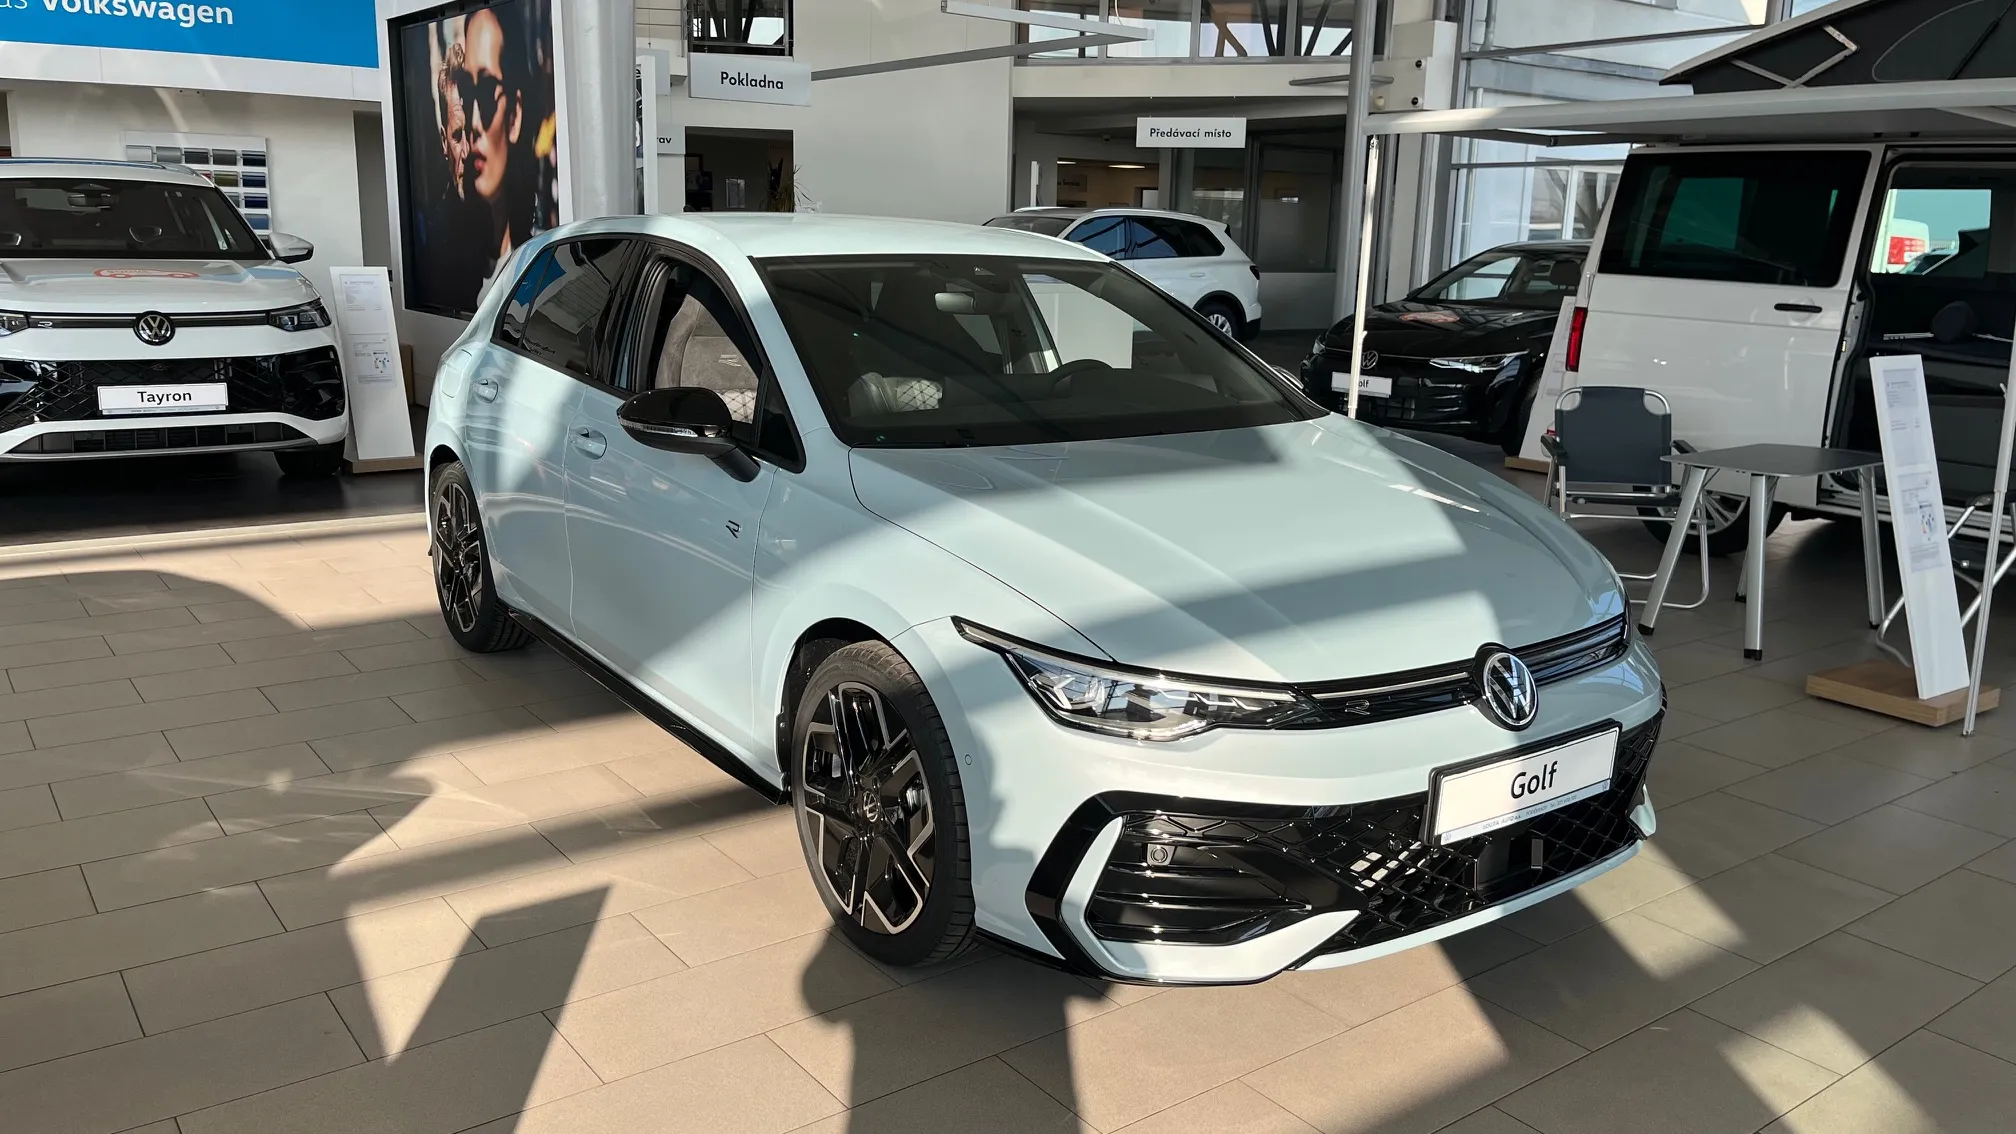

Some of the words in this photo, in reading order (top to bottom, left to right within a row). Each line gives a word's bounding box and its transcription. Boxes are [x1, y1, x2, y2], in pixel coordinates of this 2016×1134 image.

[720, 71, 784, 90] Pokladna
[1149, 127, 1201, 139] Předávací
[1204, 127, 1232, 139] místo
[1358, 379, 1370, 388] olf
[137, 391, 192, 405] Tayron
[1510, 760, 1558, 800] Golf
